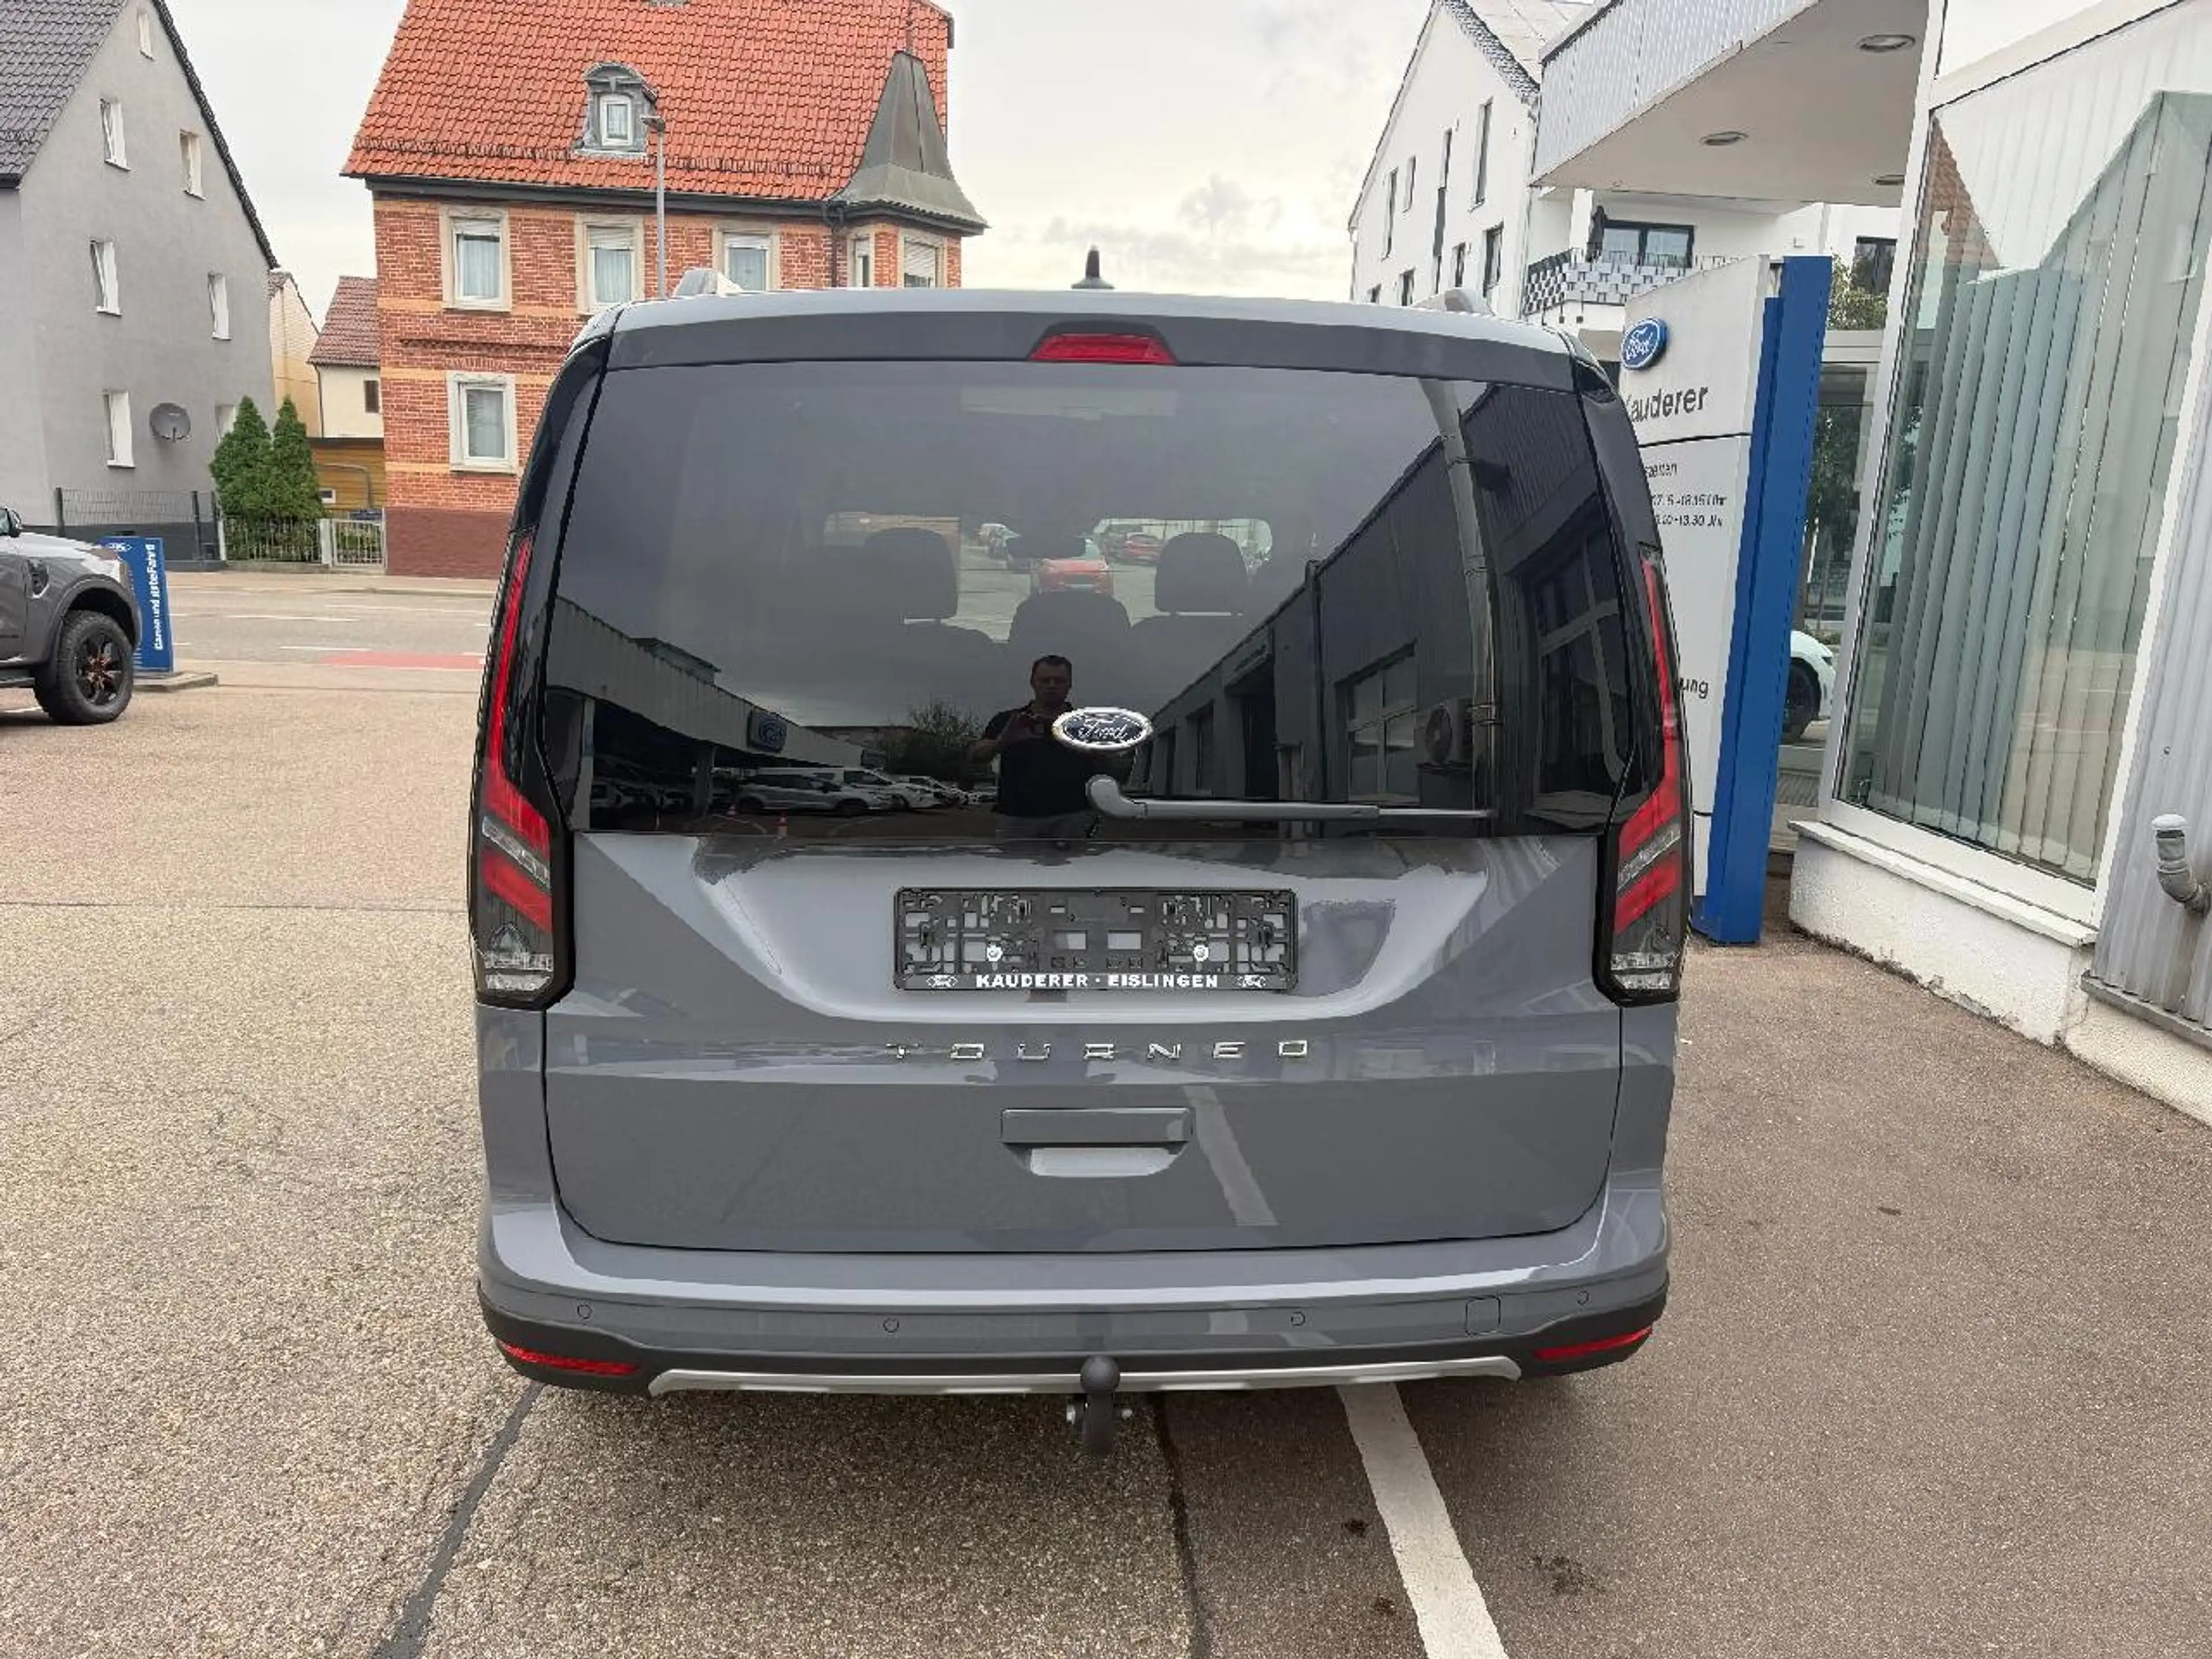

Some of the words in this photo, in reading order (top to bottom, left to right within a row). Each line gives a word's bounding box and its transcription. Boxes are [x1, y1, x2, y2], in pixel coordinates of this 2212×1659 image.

[976, 974, 1088, 988] KAUDERER
[1108, 974, 1218, 988] EISLINGEN
[885, 1040, 1308, 1059] TOURNEO
